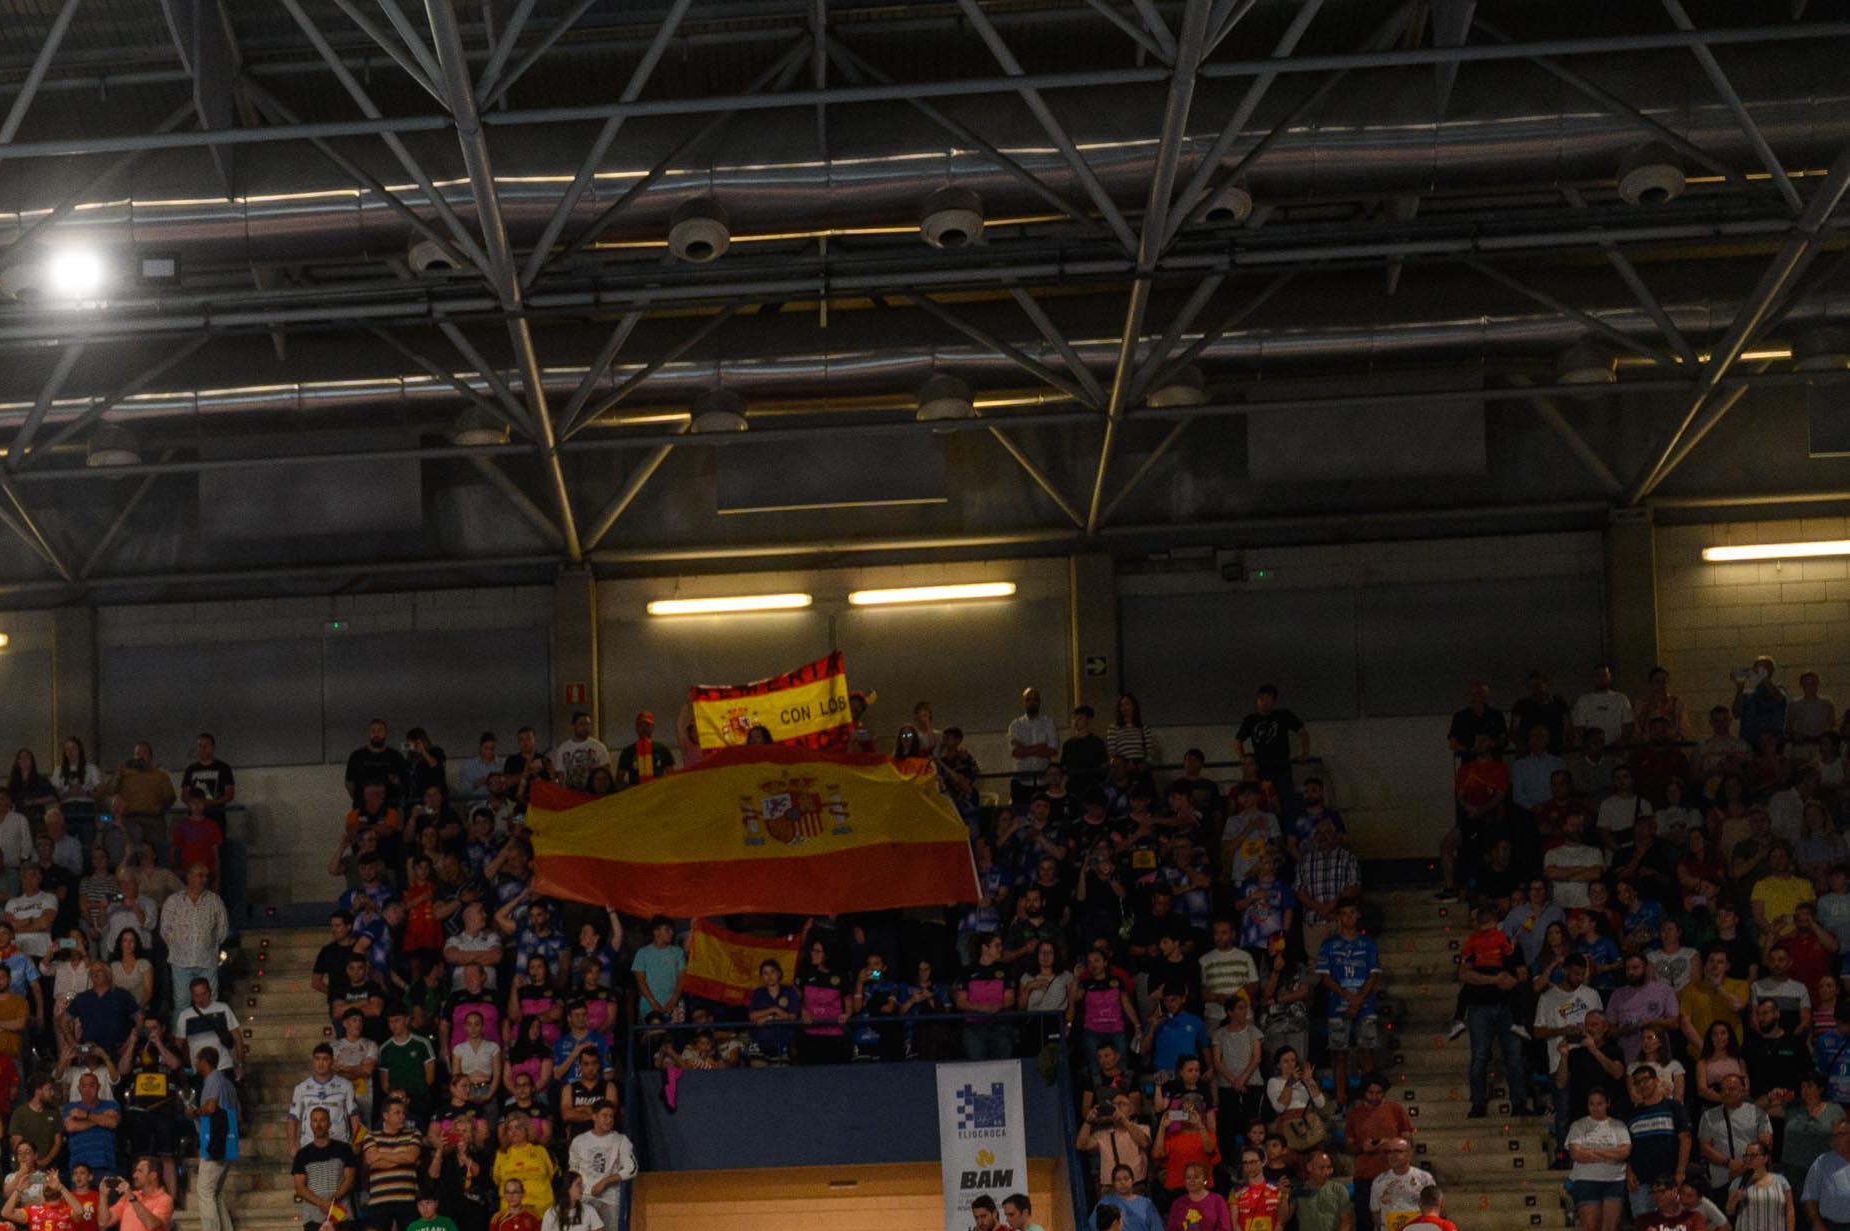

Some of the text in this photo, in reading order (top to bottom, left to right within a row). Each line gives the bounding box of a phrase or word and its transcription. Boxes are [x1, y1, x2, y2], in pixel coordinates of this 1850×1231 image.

[781, 696, 847, 724] CON LOS
[960, 1170, 1013, 1189] BAM
